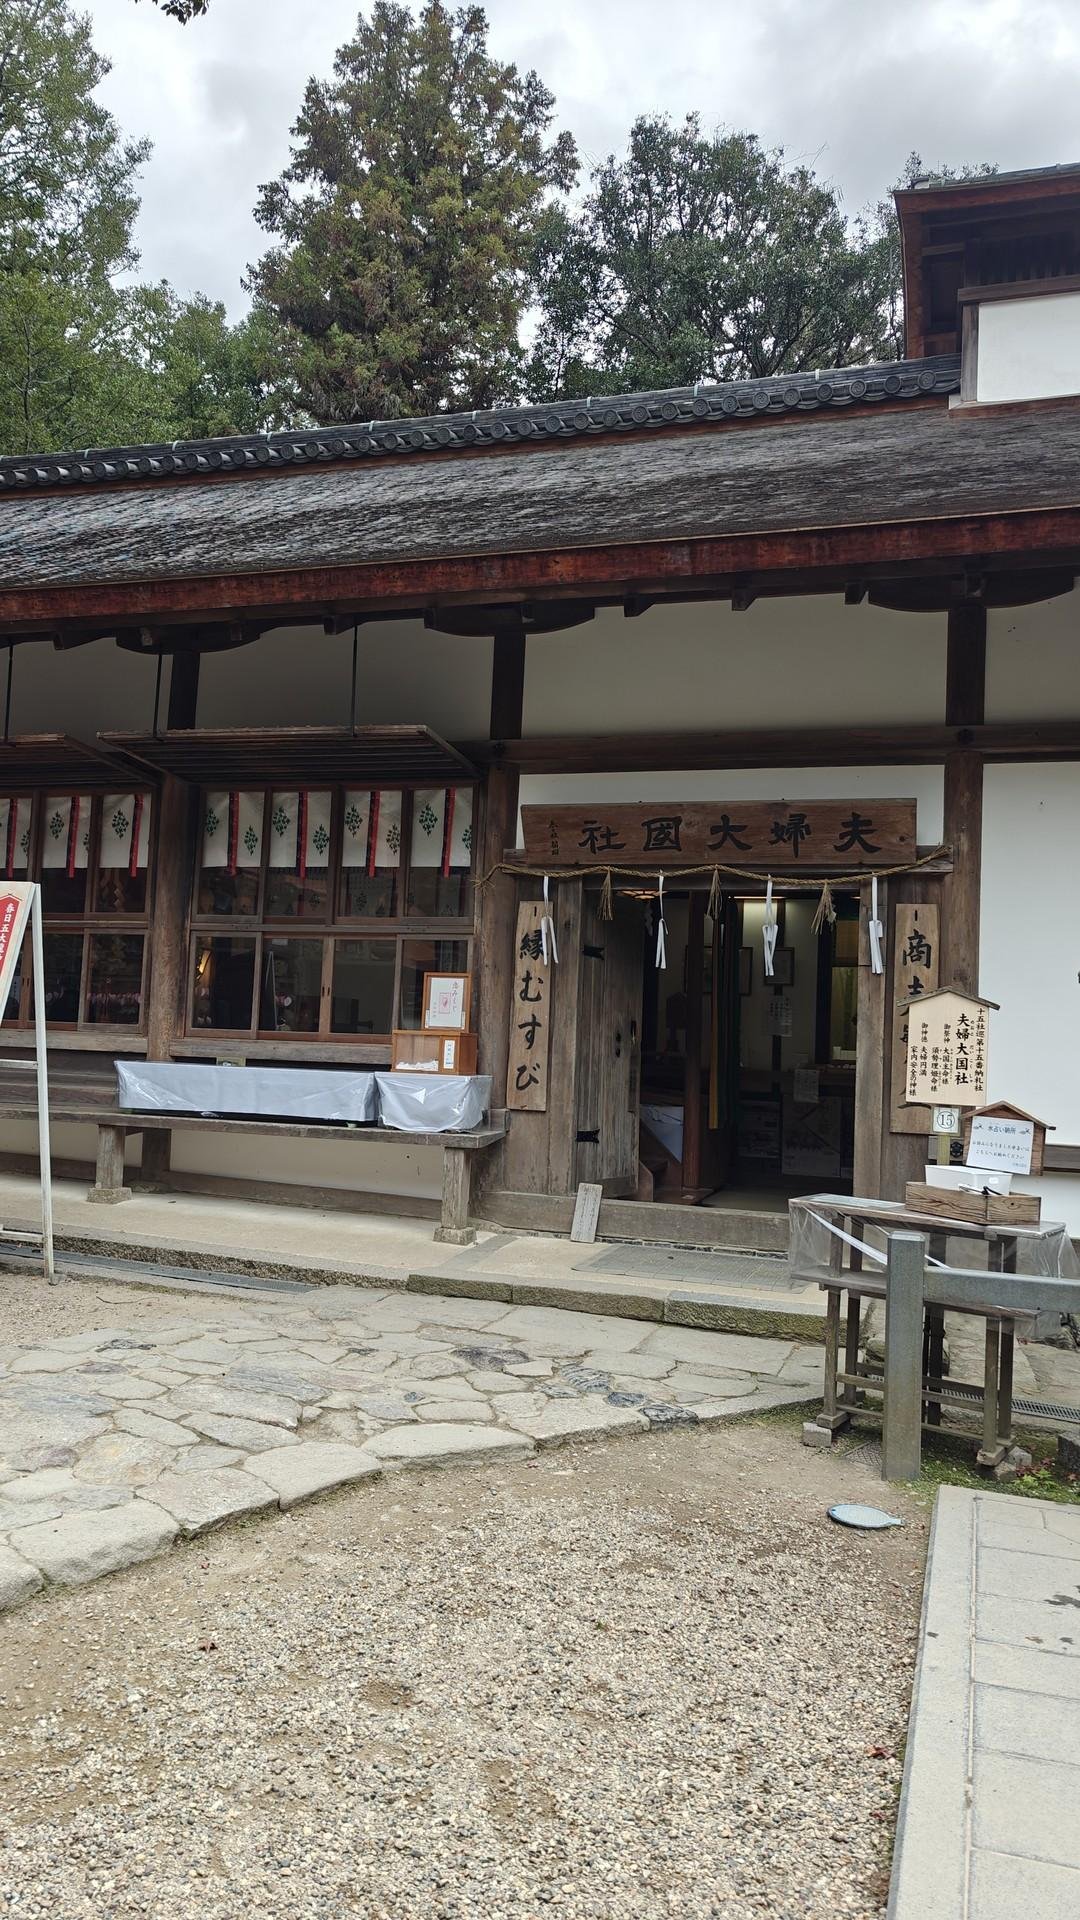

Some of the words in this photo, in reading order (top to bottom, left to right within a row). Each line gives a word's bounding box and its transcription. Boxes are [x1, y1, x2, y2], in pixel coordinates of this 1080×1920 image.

[577, 812, 882, 857] 夫婦大國社
[515, 929, 545, 1091] 縁むすび
[955, 1013, 970, 1085] 夫婦大国社
